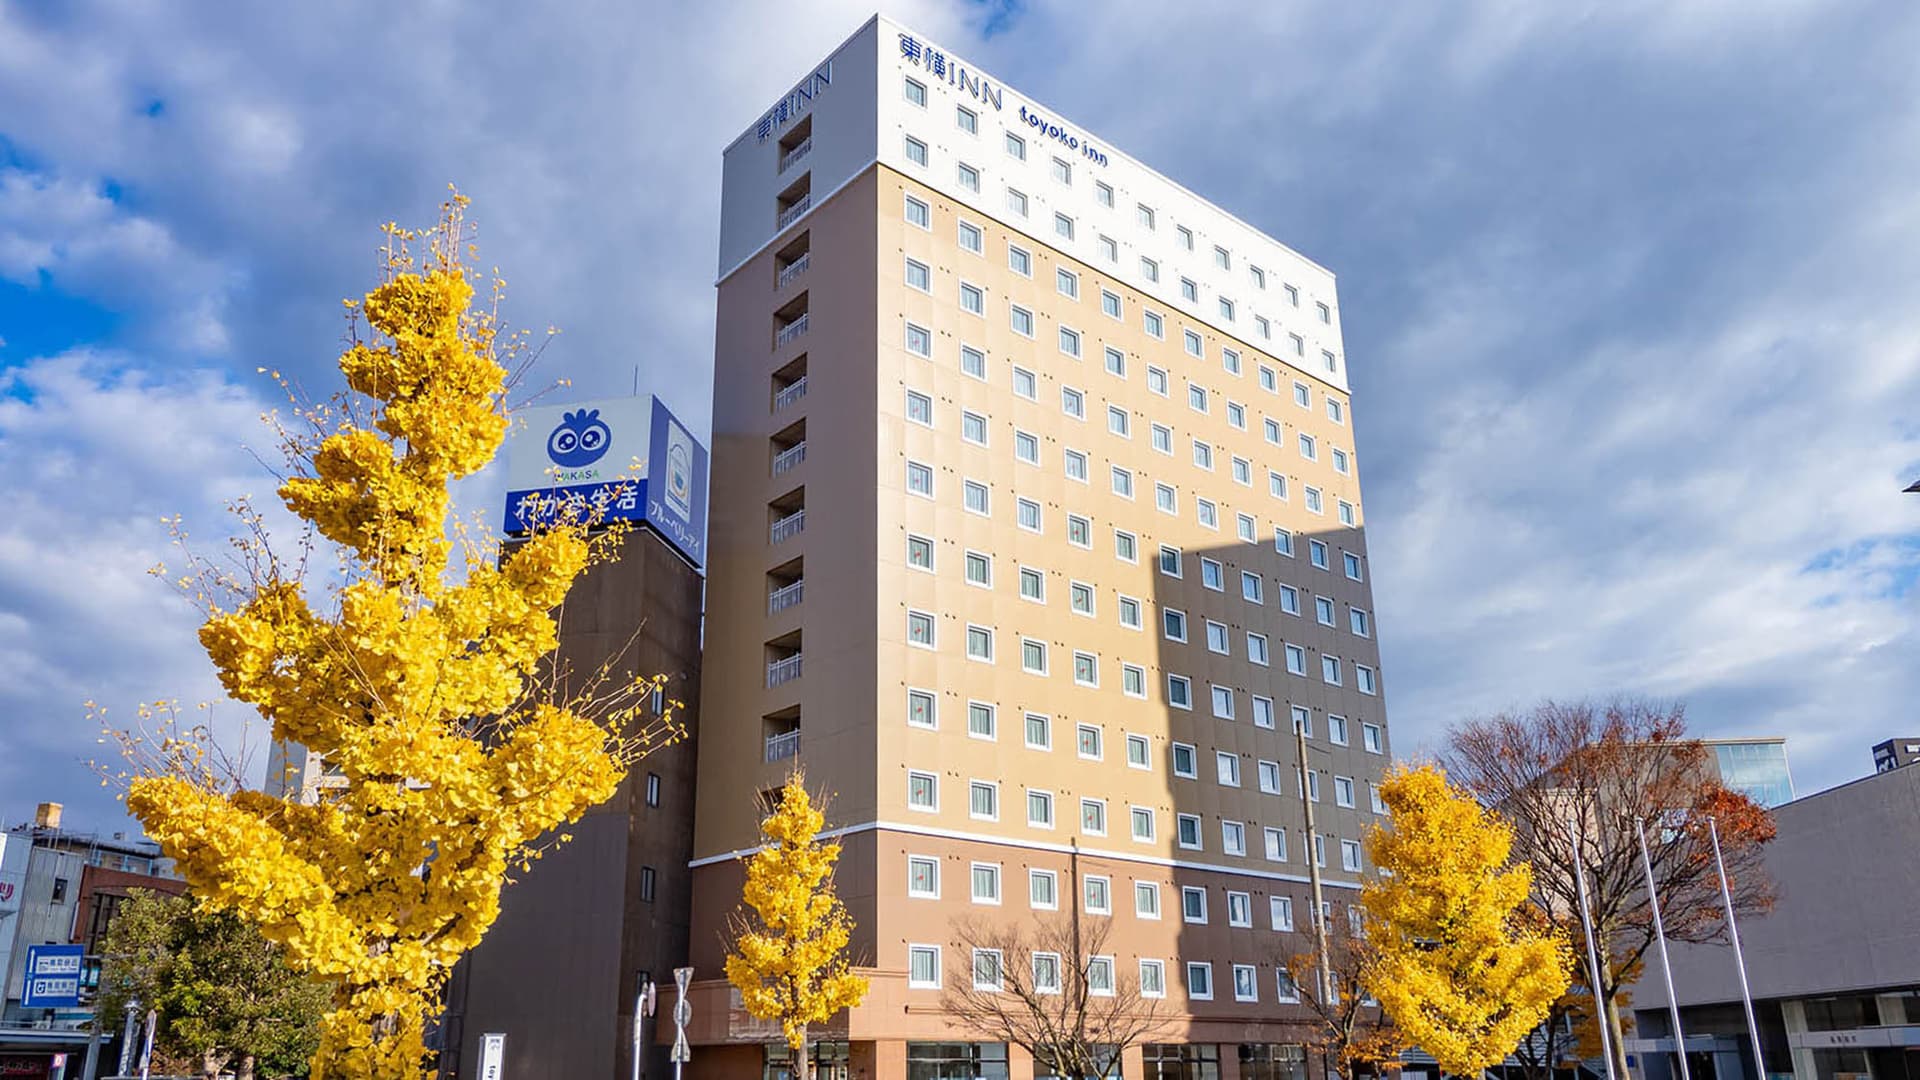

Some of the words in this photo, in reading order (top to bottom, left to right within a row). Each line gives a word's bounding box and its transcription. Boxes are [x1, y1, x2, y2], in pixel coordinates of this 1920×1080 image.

[757, 59, 832, 141] 東横INN
[899, 33, 1003, 112] 東横INN
[1019, 105, 1079, 151] toyoko
[1080, 140, 1109, 168] inn
